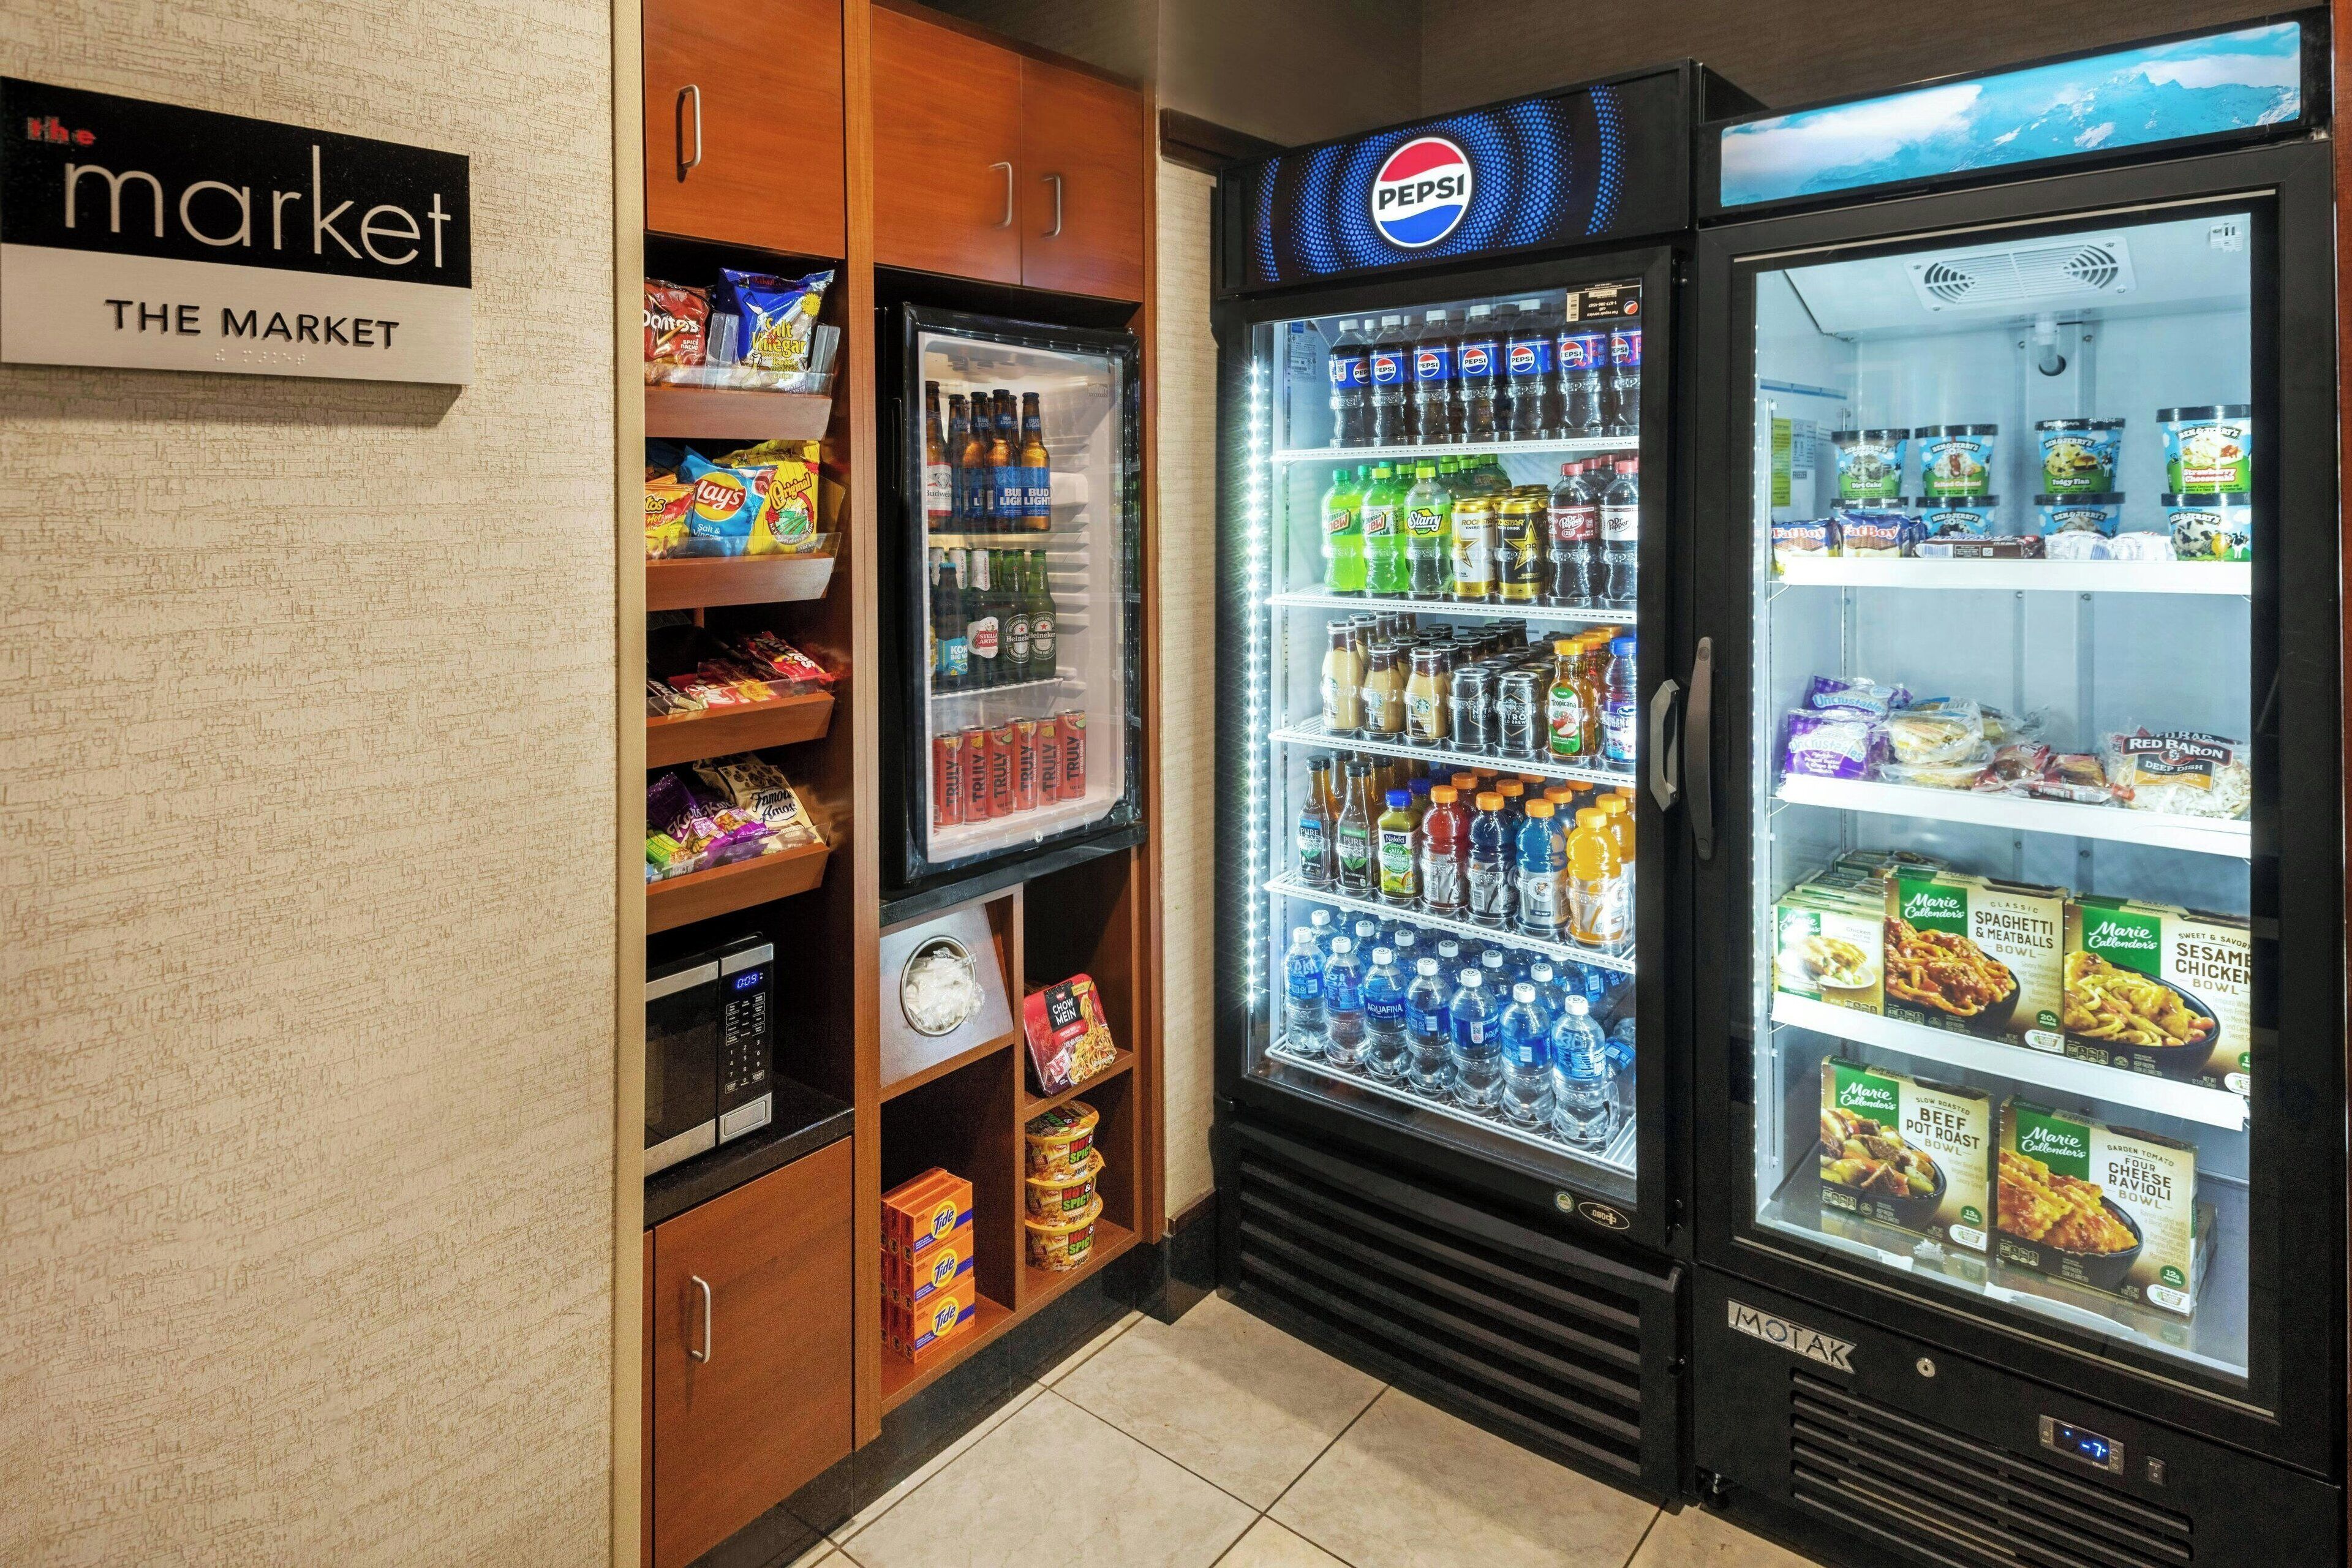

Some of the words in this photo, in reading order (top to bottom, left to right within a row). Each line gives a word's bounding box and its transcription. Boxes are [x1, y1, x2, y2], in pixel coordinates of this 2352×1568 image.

[27, 116, 96, 146] the
[1379, 174, 1464, 210] PEPSI
[65, 145, 451, 268] market
[105, 299, 201, 334] THE
[221, 307, 399, 349] MARKET
[766, 317, 793, 338] Salt
[752, 331, 807, 358] Vinegar
[696, 480, 744, 510] Lay's
[768, 472, 812, 510] Original
[1028, 488, 1049, 497] BUD
[1000, 497, 1022, 506] LIGH
[698, 523, 713, 532] Salt
[1408, 510, 1443, 531] Starry
[1608, 519, 1629, 530] Pepper
[951, 645, 967, 655] KON
[1551, 699, 1577, 709] Tropicana
[1813, 694, 1887, 716] Uncrustables
[1067, 736, 1079, 781] TRULY
[2129, 739, 2163, 750] RED
[2165, 739, 2224, 759] BARON
[993, 752, 1006, 799] TRULY
[1020, 745, 1033, 792] TRULY
[1042, 744, 1057, 792] TRULY
[2145, 761, 2174, 772] DEEP
[946, 760, 959, 807] TRULY
[972, 754, 985, 803] TRULY
[751, 788, 795, 813] Famous
[761, 803, 796, 823] Amos
[1300, 827, 1319, 837] PURE
[1343, 835, 1363, 845] PURE
[1904, 892, 1960, 910] Marie
[1990, 901, 2038, 913] CLASSIC
[1904, 906, 1964, 919] Callender's
[1975, 911, 2053, 935] SPAGHETTI
[2089, 921, 2152, 939] Marie
[1976, 927, 1985, 938] &
[1987, 930, 2053, 949] MEATBALLS
[2088, 935, 2157, 950] Callender's
[1996, 943, 2036, 959] BOWL
[2193, 978, 2239, 995] BOWL
[1052, 997, 1074, 1014] CHOW
[1367, 1002, 1403, 1014] AQUAFINA
[1055, 1008, 1077, 1026] MEIN
[1840, 1082, 1892, 1100] Marie
[1840, 1094, 1896, 1110] Callender's
[1938, 1100, 1970, 1115] ROASTED
[1920, 1107, 1967, 1130] BEEF
[1907, 1119, 1932, 1135] POT
[1936, 1127, 1980, 1150] ROAST
[2022, 1126, 2081, 1147] Marie
[1924, 1140, 1962, 1156] BOWL
[2021, 1139, 2087, 1159] Callender's
[2106, 1144, 2138, 1155] GARDEN
[2142, 1150, 2174, 1167] TOMATO
[2125, 1158, 2155, 1172] FOUR
[2108, 1162, 2171, 1189] CHEESE
[1063, 1186, 1085, 1200] HOT
[1085, 1184, 1091, 1193] &
[2108, 1174, 2171, 1201] RAVIOLI
[1063, 1193, 1090, 1211] SPICY
[2119, 1190, 2163, 1210] BOWL
[933, 1209, 954, 1236] Tide
[1069, 1235, 1093, 1256] SPICY
[934, 1256, 955, 1285] Tide
[934, 1304, 956, 1333] Tide
[1735, 1306, 1845, 1366] MOTAK
